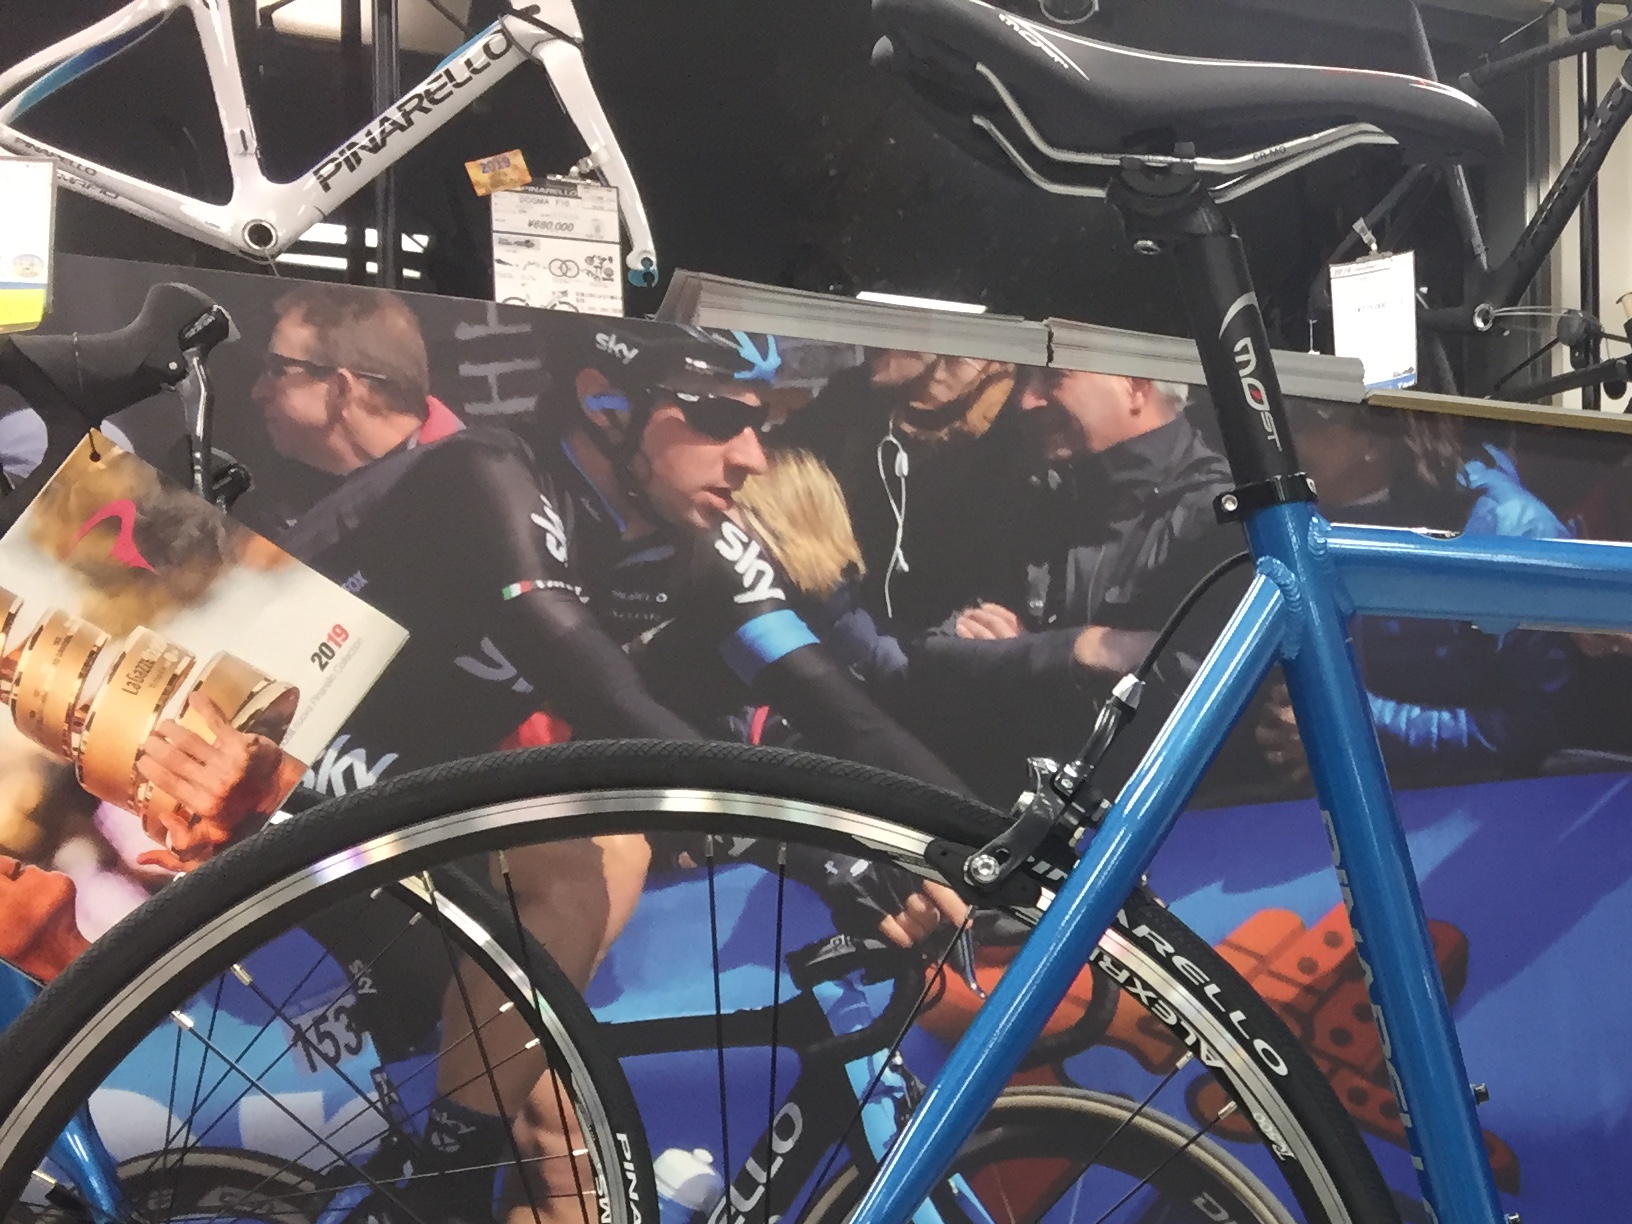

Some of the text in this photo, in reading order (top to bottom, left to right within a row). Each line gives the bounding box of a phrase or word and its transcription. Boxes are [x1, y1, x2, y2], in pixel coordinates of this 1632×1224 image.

[313, 29, 513, 193] PINARELLO
[595, 332, 638, 365] sky
[714, 521, 786, 603] sky
[311, 623, 350, 672] 2019
[292, 1004, 363, 1073] 153
[1090, 947, 1226, 1068] ALEXRI
